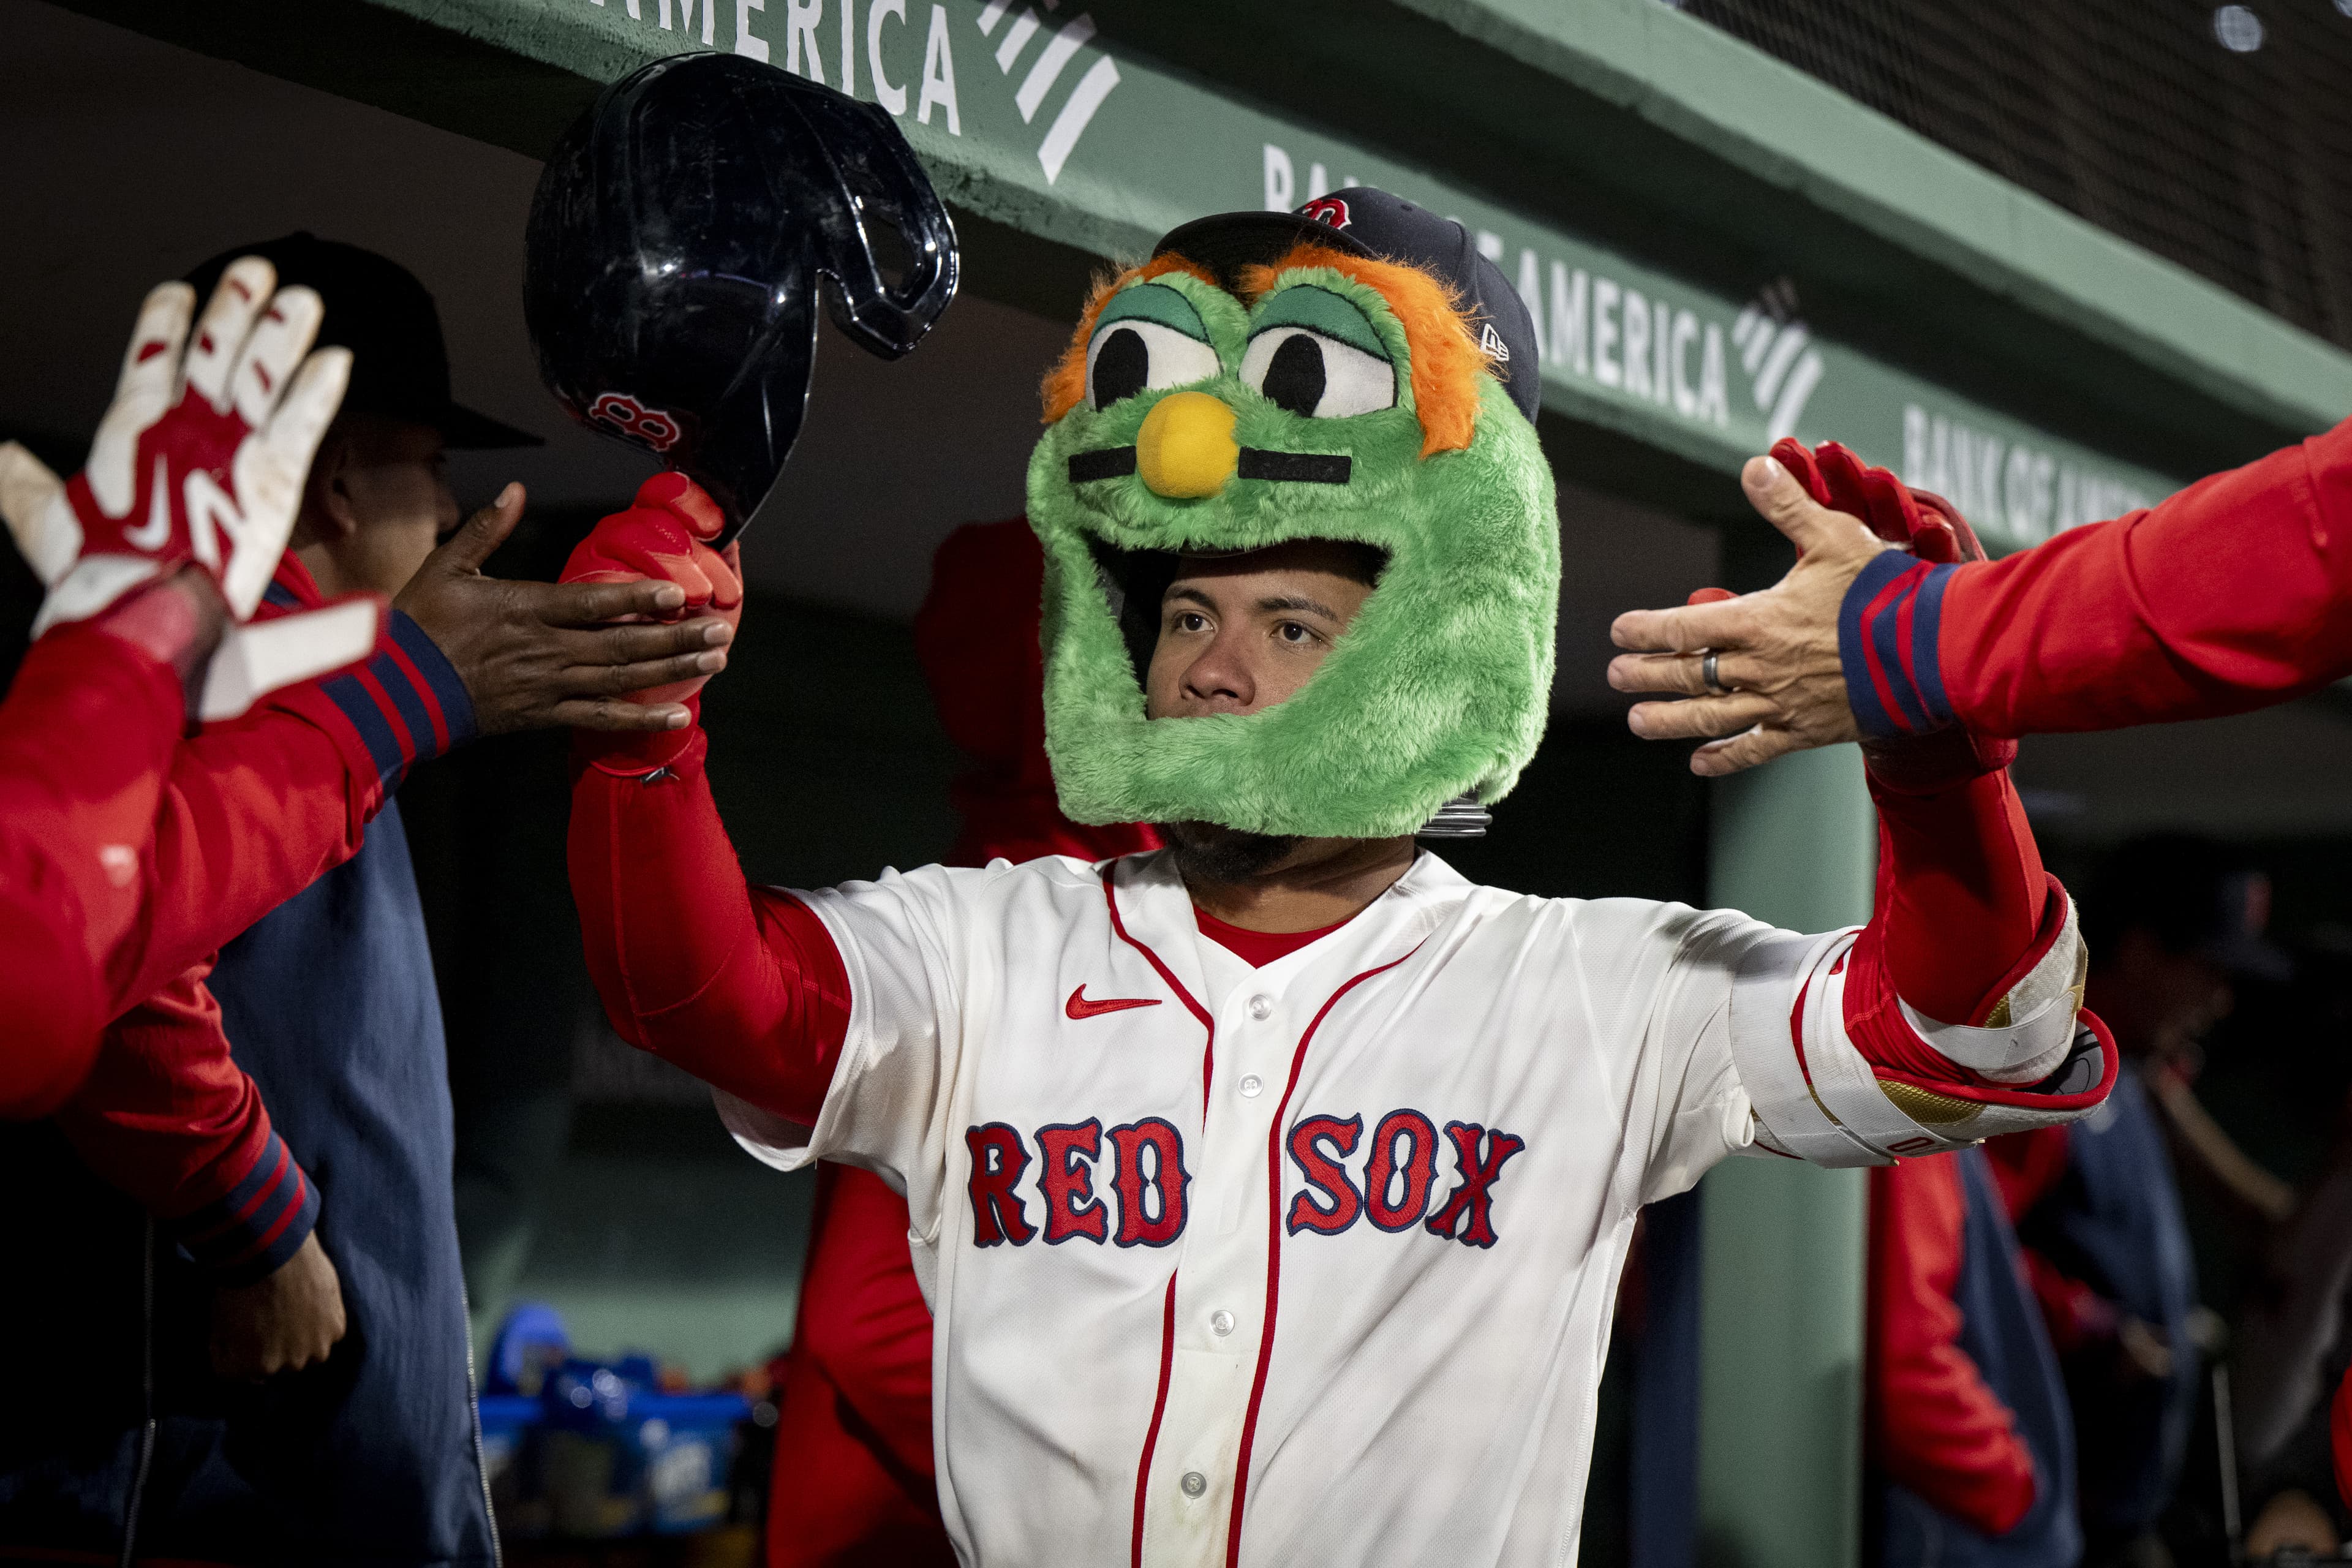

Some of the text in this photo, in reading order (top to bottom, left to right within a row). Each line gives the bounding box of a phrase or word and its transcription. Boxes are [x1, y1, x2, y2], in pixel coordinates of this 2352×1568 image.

[589, 0, 960, 136] ERICA
[1518, 248, 1732, 427] AMERICA
[589, 391, 681, 452] B
[965, 1109, 1525, 1249] RED SOX
